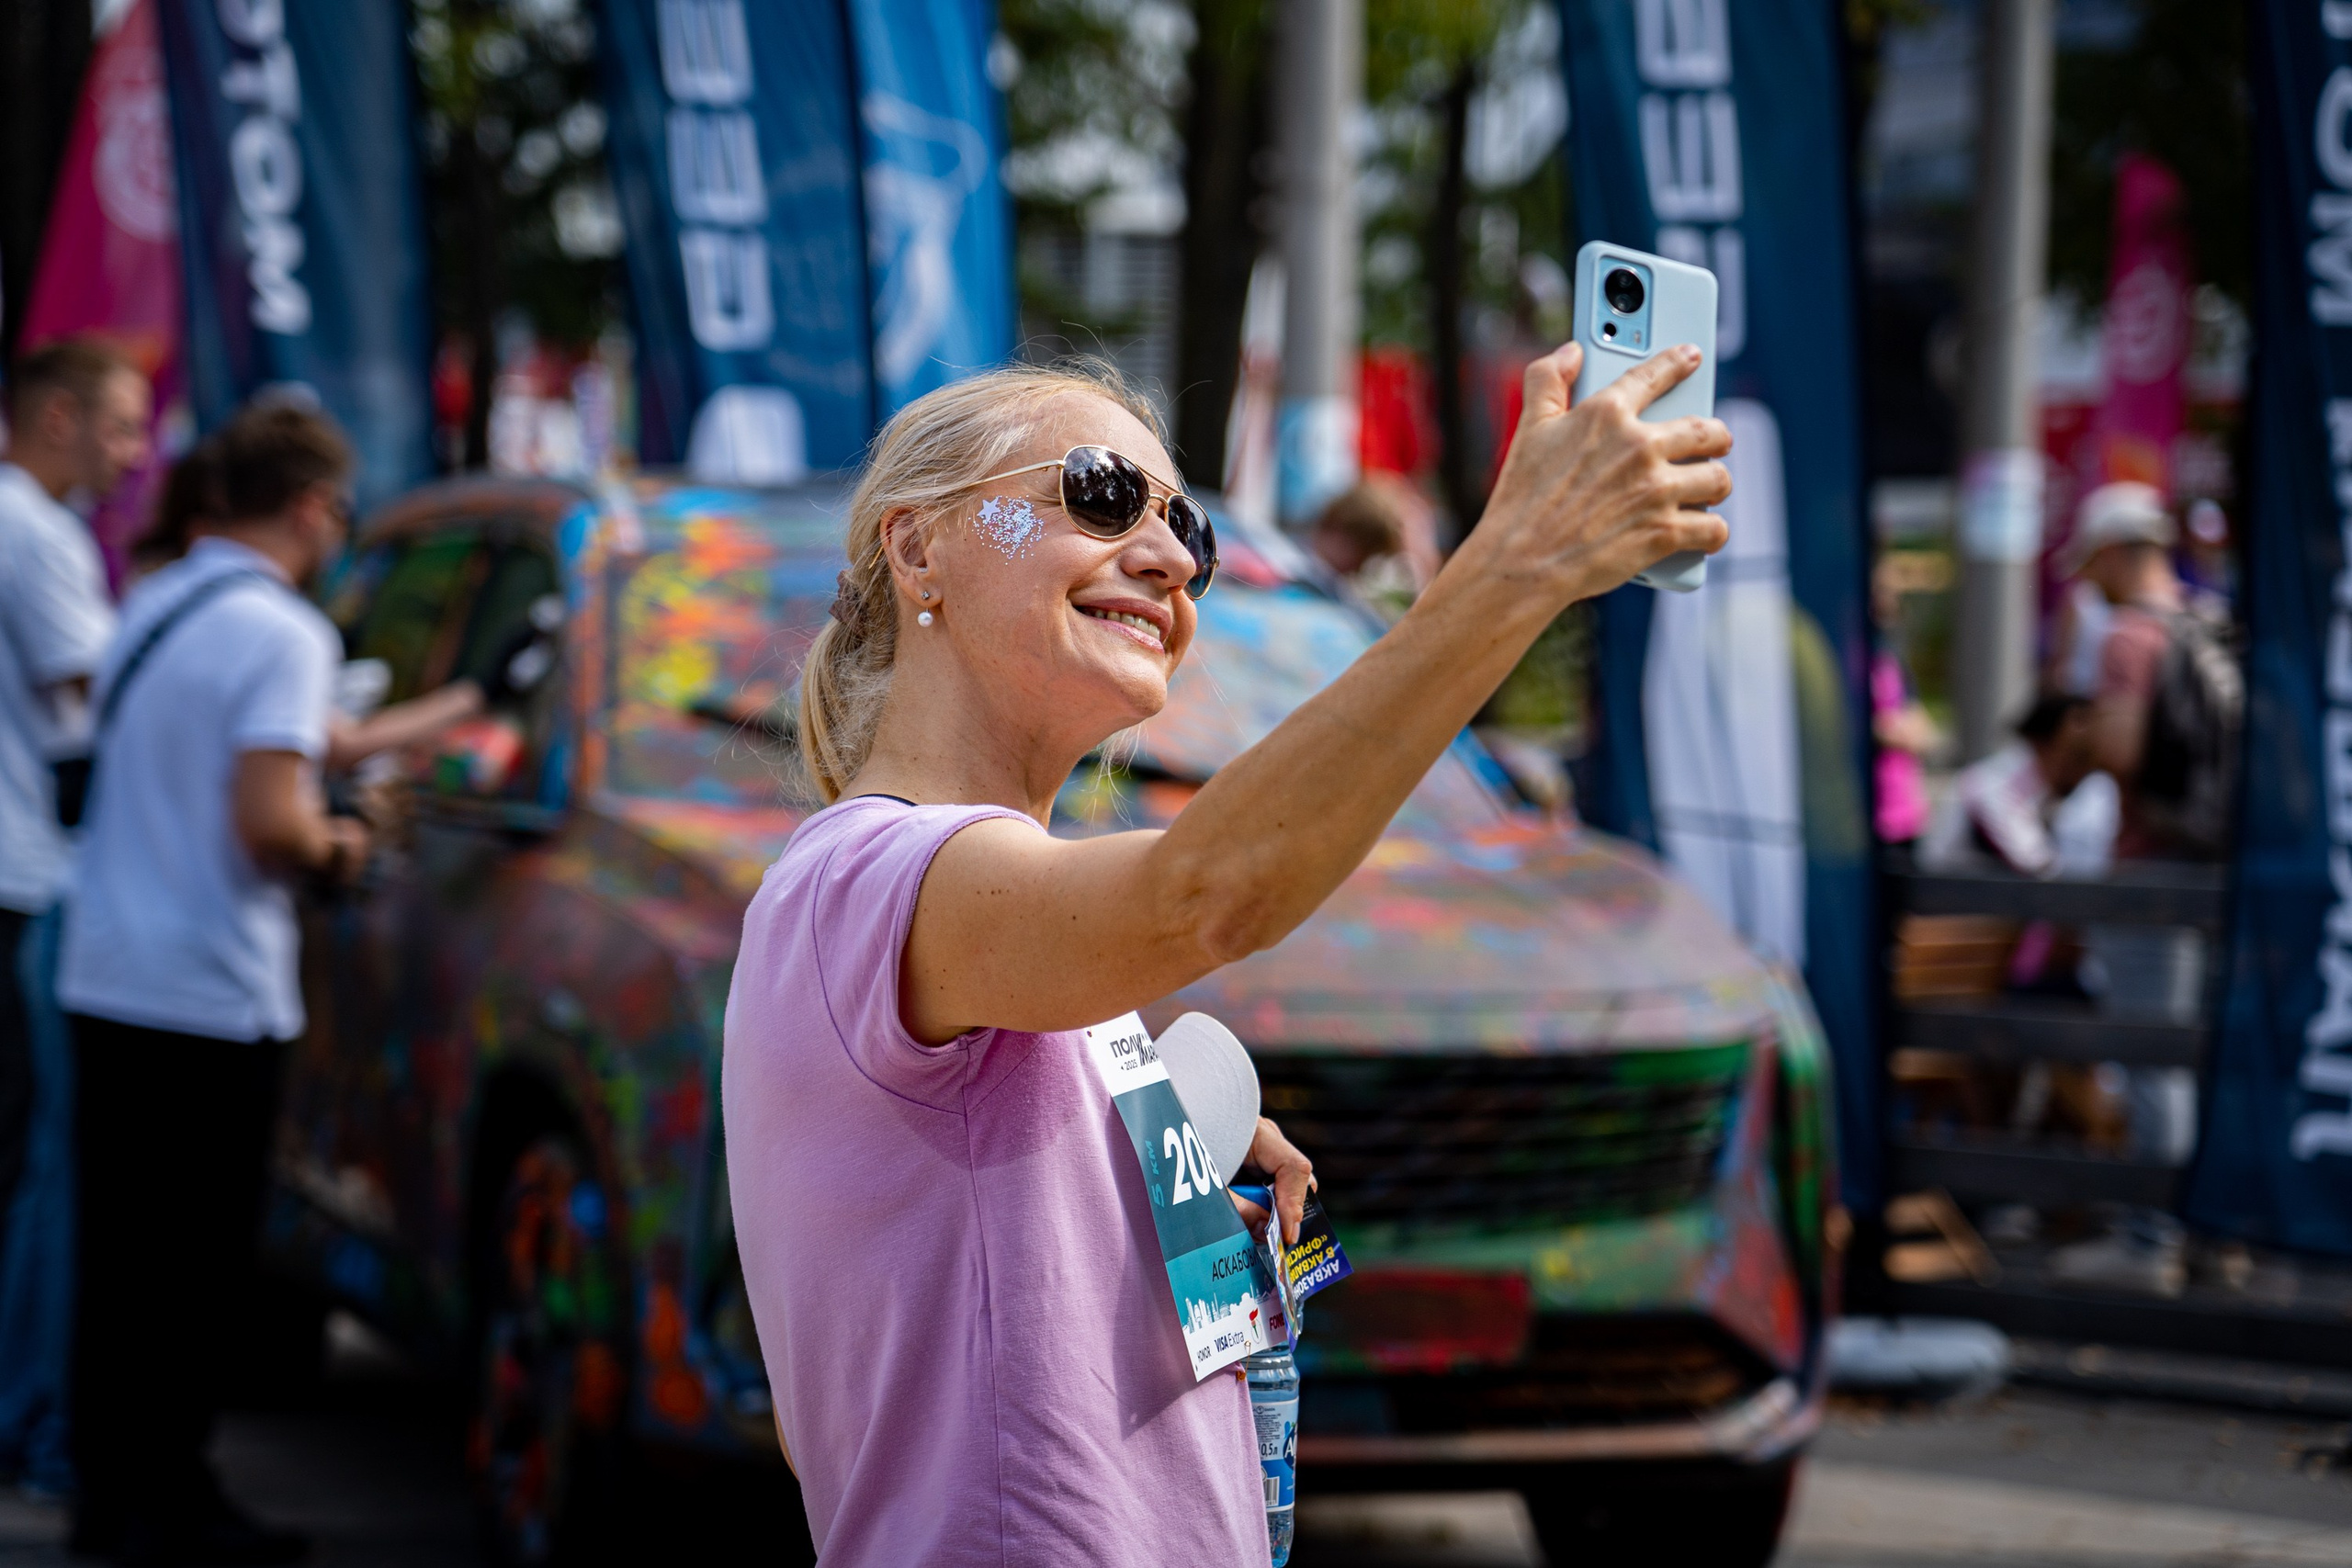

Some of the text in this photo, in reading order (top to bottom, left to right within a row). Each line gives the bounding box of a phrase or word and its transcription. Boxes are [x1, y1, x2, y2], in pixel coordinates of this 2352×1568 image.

[1124, 1058, 1138, 1071] 2025
[1151, 1183, 1165, 1208] 5
[1326, 1246, 1335, 1258] В
[1214, 1331, 1245, 1353] VISA Extra
[1196, 1346, 1212, 1362] HONOR
